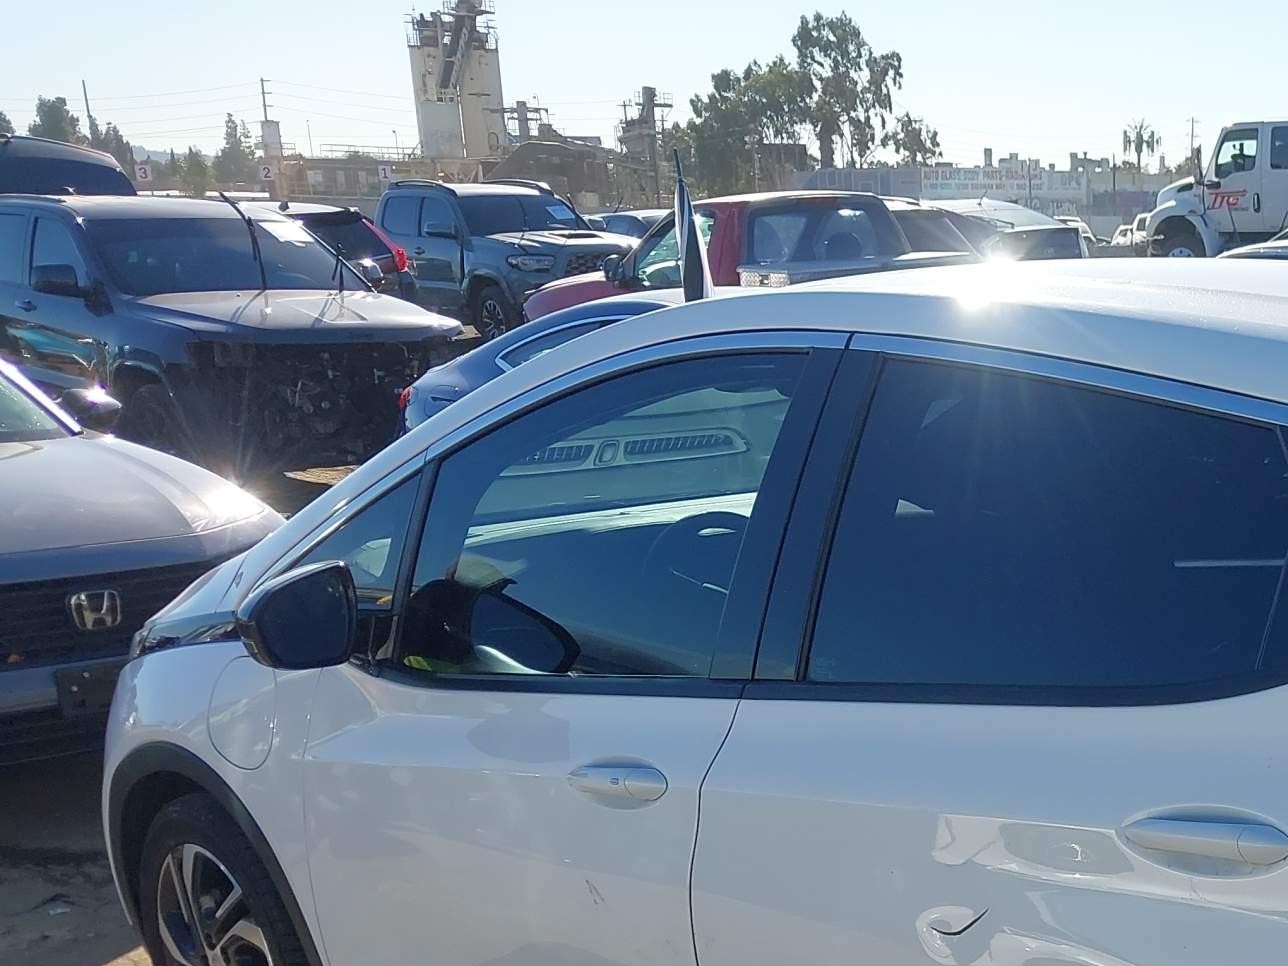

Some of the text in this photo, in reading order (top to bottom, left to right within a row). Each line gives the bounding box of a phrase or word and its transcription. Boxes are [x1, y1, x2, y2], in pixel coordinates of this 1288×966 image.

[138, 166, 148, 179] 3
[262, 166, 273, 179] 2
[381, 167, 389, 179] 1
